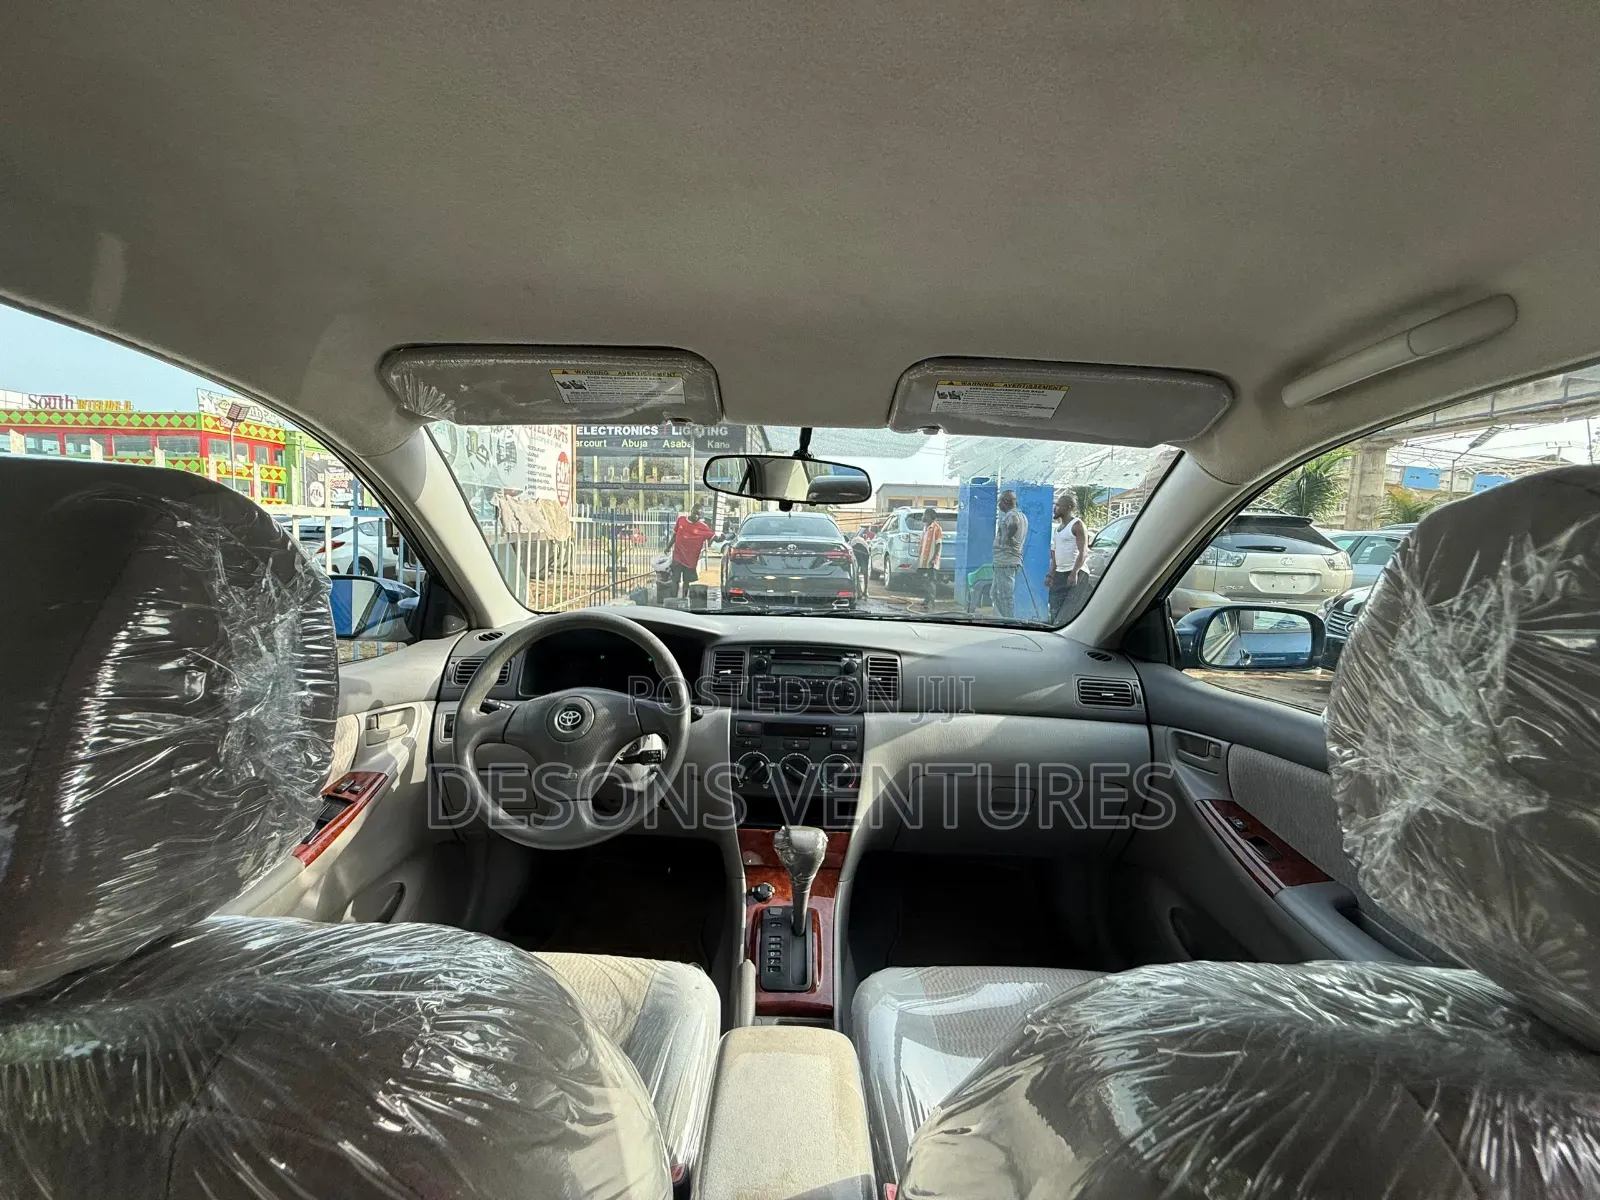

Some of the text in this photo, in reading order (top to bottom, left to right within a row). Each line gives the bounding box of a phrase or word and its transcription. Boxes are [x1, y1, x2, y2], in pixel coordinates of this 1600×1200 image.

[1003, 382, 1063, 390] AVERTISSEMENT
[28, 394, 74, 410] South
[576, 426, 659, 436] ELECTRONICS
[671, 426, 728, 436] LIGING
[575, 439, 607, 448] arcourt
[621, 439, 648, 449] Abuja
[707, 440, 730, 449] Kano
